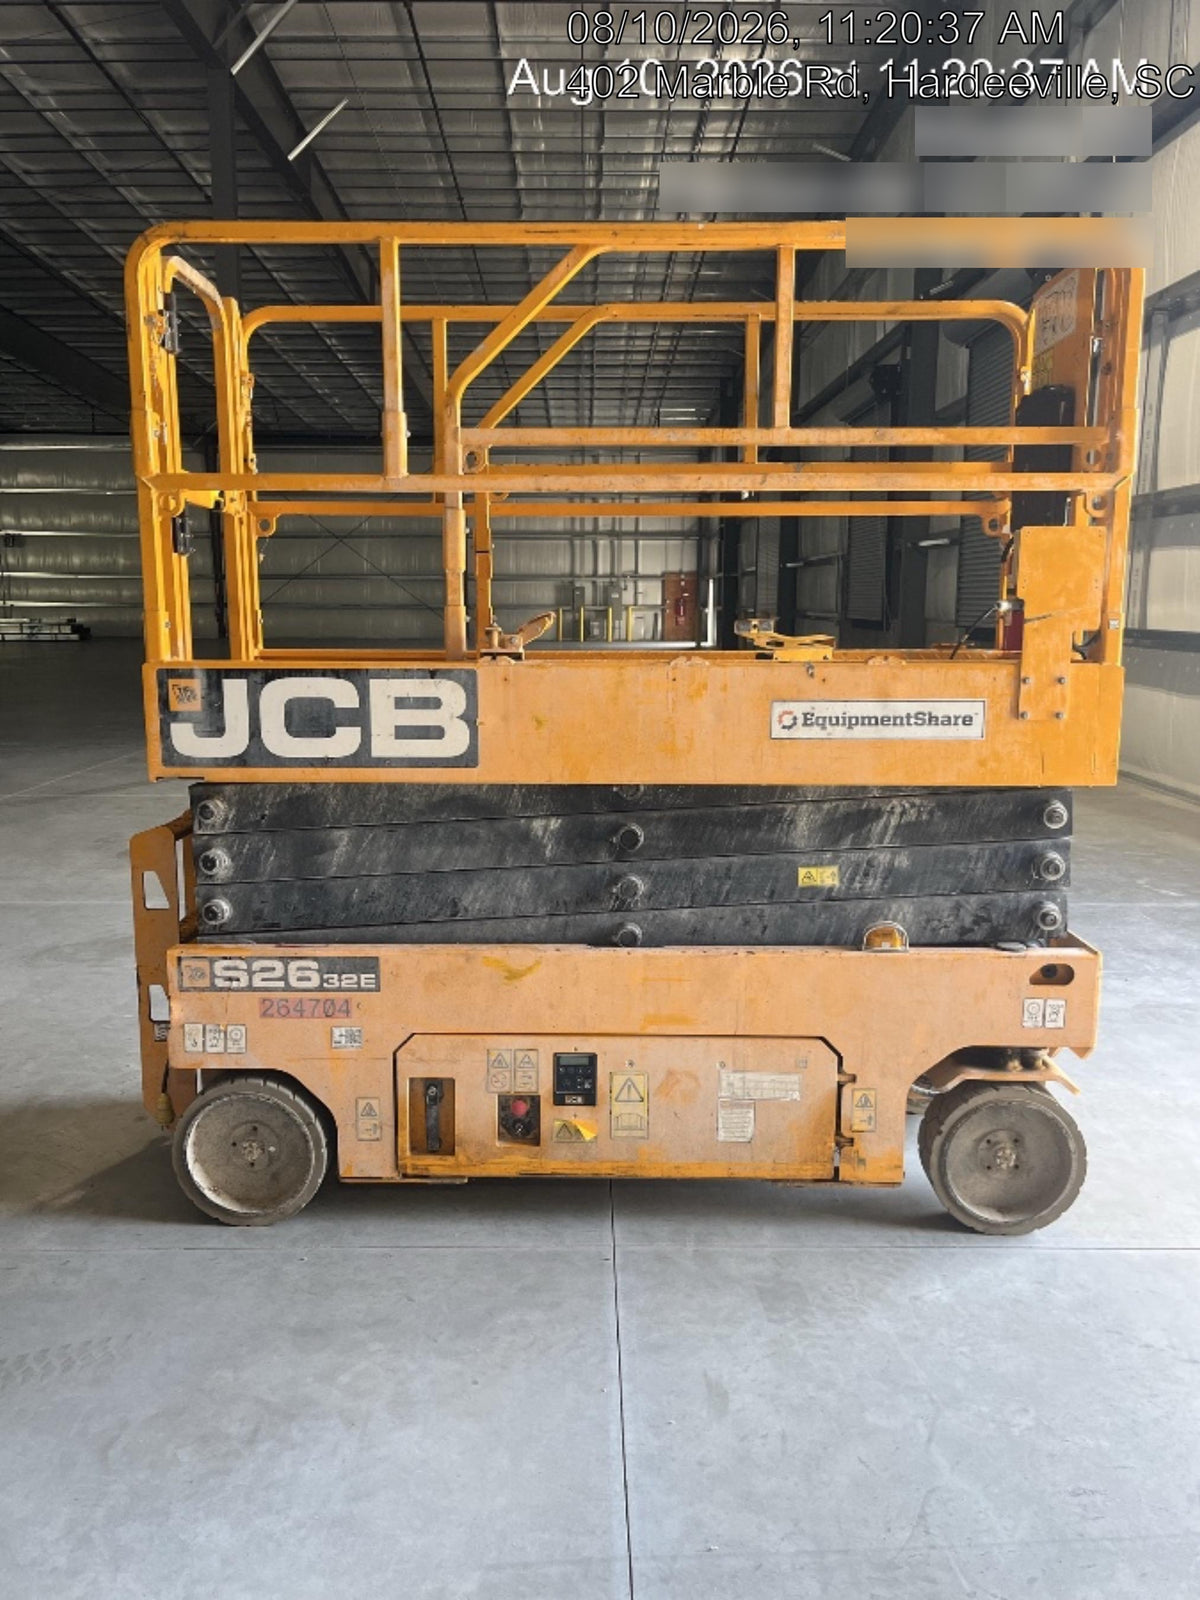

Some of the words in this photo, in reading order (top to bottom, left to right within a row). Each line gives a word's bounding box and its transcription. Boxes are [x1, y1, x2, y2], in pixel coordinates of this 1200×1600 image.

[169, 676, 470, 758] JCB
[801, 711, 974, 730] EquipmentShare
[260, 998, 351, 1017] 264704
